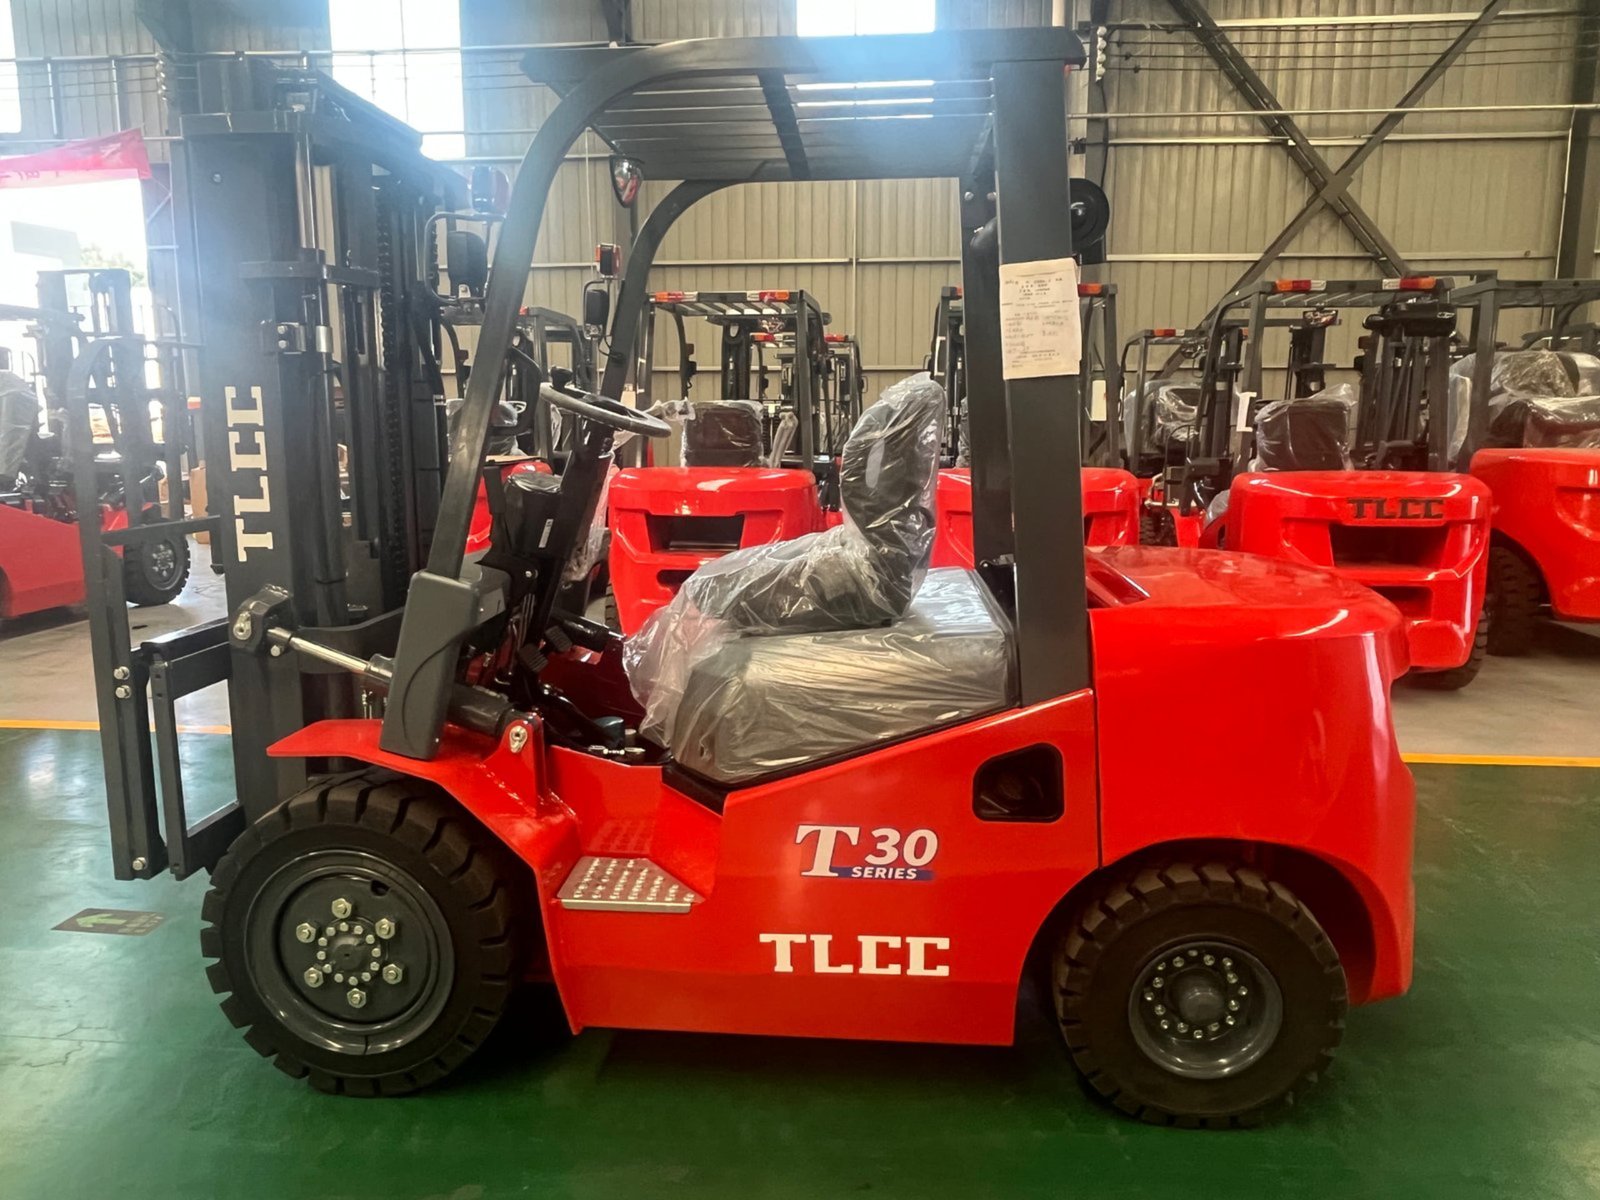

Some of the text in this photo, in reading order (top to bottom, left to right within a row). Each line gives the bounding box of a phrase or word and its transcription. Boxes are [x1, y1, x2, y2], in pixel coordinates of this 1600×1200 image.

[224, 386, 274, 562] TLCC
[1346, 497, 1445, 519] TLCC
[851, 866, 918, 880] SERIES
[759, 933, 950, 977] TLCC
